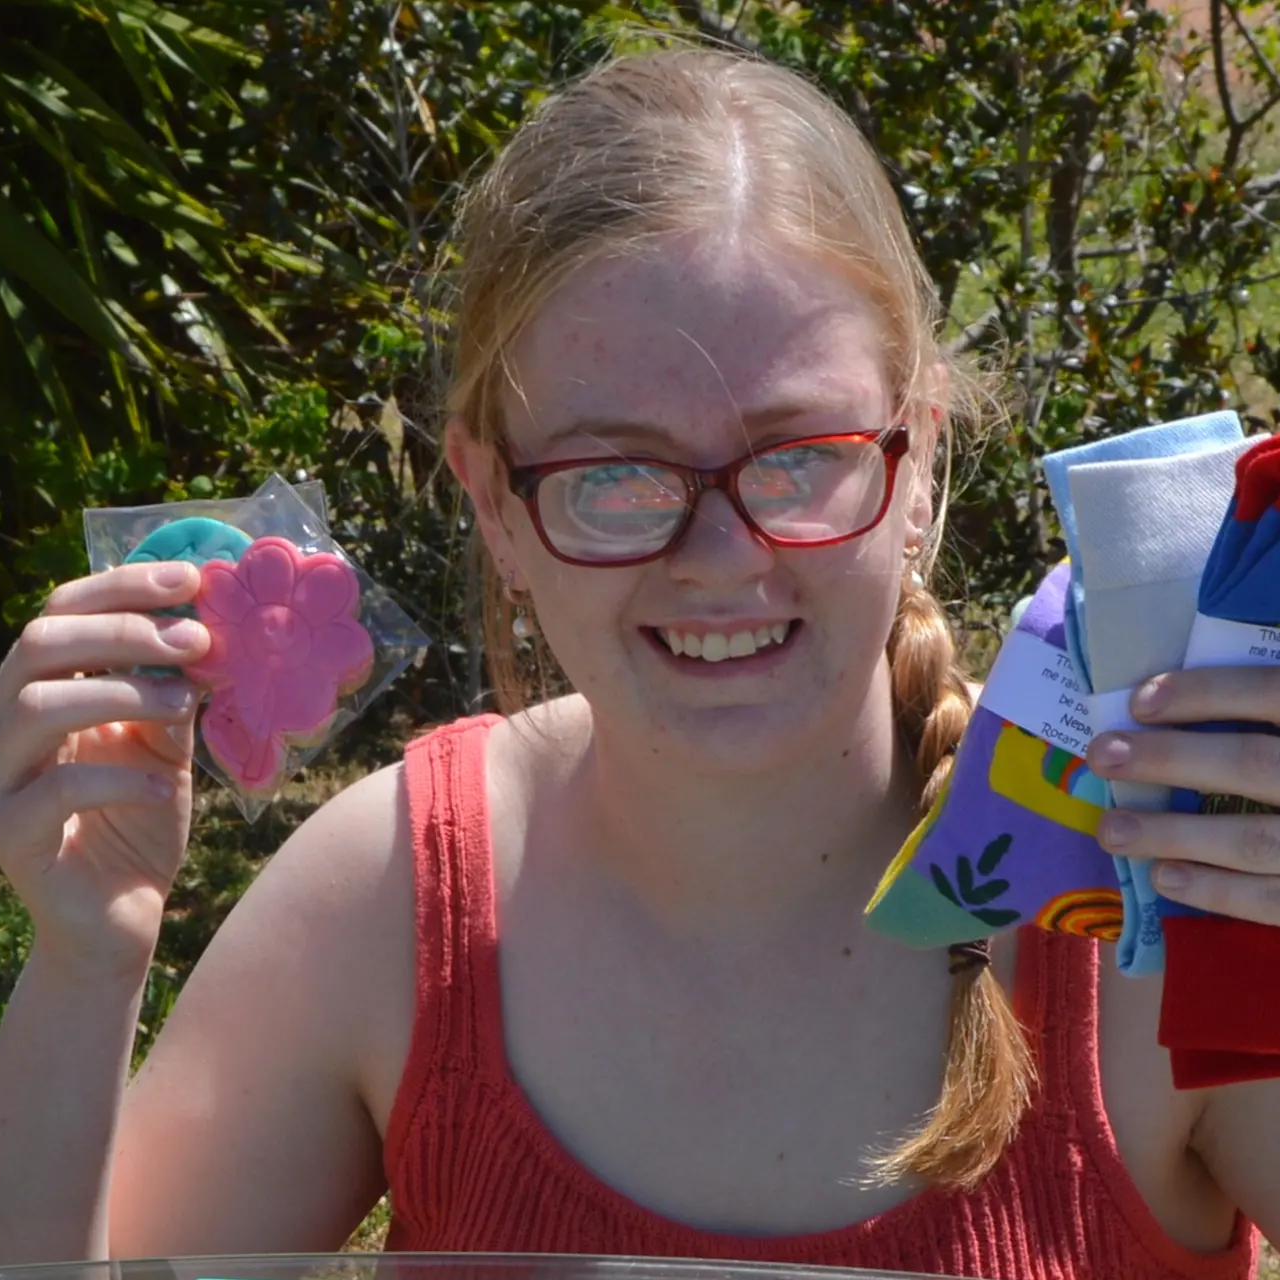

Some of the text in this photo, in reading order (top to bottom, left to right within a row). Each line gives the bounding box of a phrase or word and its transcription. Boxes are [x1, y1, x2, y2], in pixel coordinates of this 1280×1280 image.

[1249, 645, 1268, 657] me
[1041, 667, 1059, 681] me
[1058, 693, 1074, 708] be
[1041, 721, 1081, 749] Rotary
